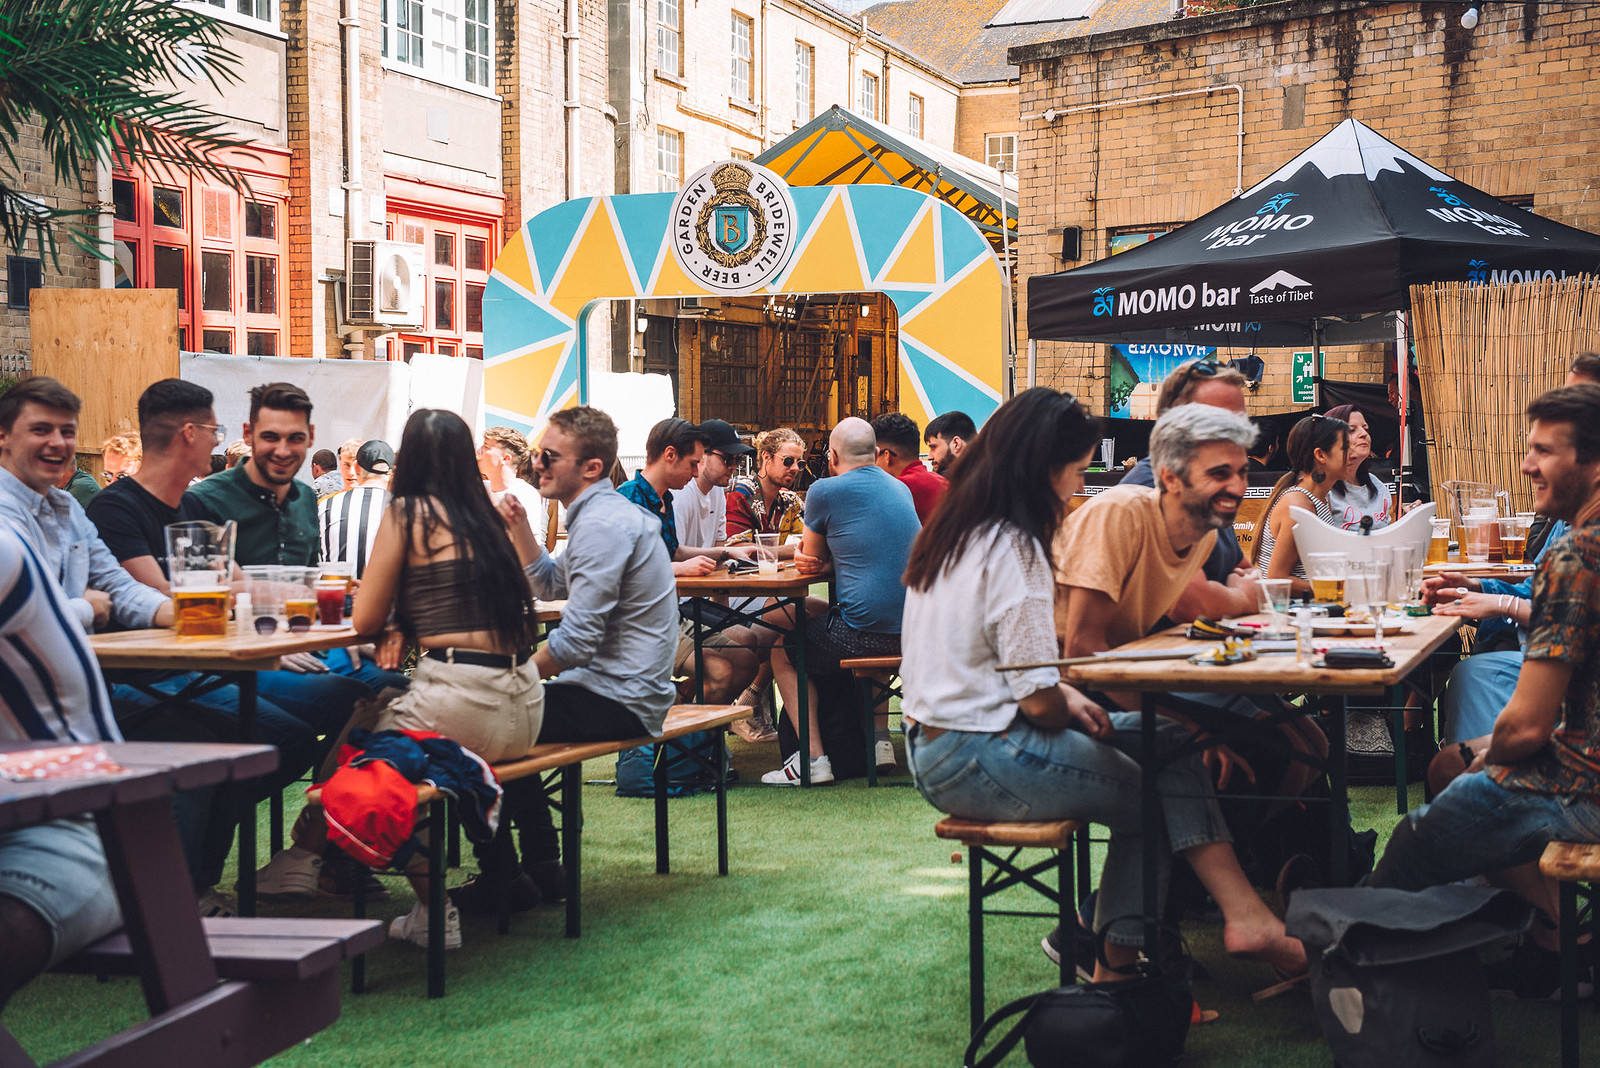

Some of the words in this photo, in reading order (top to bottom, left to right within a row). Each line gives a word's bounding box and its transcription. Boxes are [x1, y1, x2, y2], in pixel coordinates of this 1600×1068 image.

[679, 183, 707, 255] GARDEN
[721, 213, 741, 244] B
[754, 181, 785, 272] BRIDEWELL
[1200, 214, 1314, 242] MOMO
[1426, 207, 1522, 229] MOMO
[1471, 221, 1530, 238] bar
[1205, 233, 1267, 251] bar
[701, 264, 740, 284] BEER
[1117, 284, 1197, 317] MOMO
[1201, 282, 1241, 308] bar
[1249, 293, 1274, 305] Taste
[1276, 290, 1288, 302] of
[1288, 290, 1314, 302] Tibet
